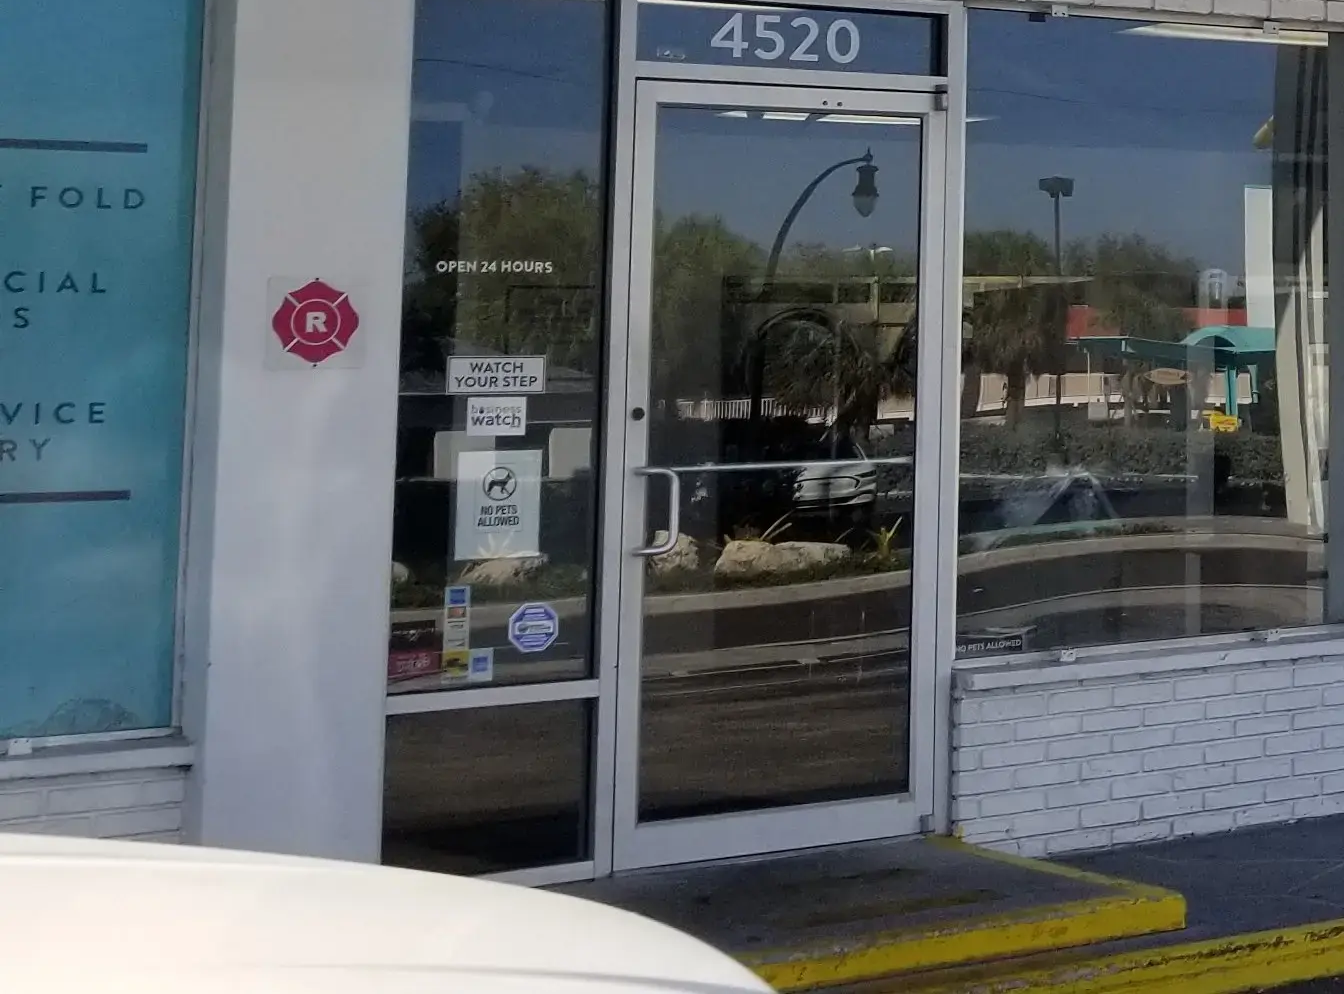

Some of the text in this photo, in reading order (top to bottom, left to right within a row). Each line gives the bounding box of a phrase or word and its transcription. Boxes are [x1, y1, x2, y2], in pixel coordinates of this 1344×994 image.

[710, 12, 860, 64] 4520
[30, 186, 145, 209] FOLD
[436, 260, 553, 274] OPEN 24 HOURS
[3, 271, 107, 294] CIAL
[13, 307, 30, 329] S
[305, 311, 328, 333] R
[469, 362, 524, 374] WATCH
[454, 376, 538, 388] YOUR STEP
[0, 402, 106, 425] VICE
[471, 412, 521, 427] watch
[0, 437, 52, 462] RY
[477, 516, 520, 527] ALLOWED
[480, 505, 518, 516] NO PETS
